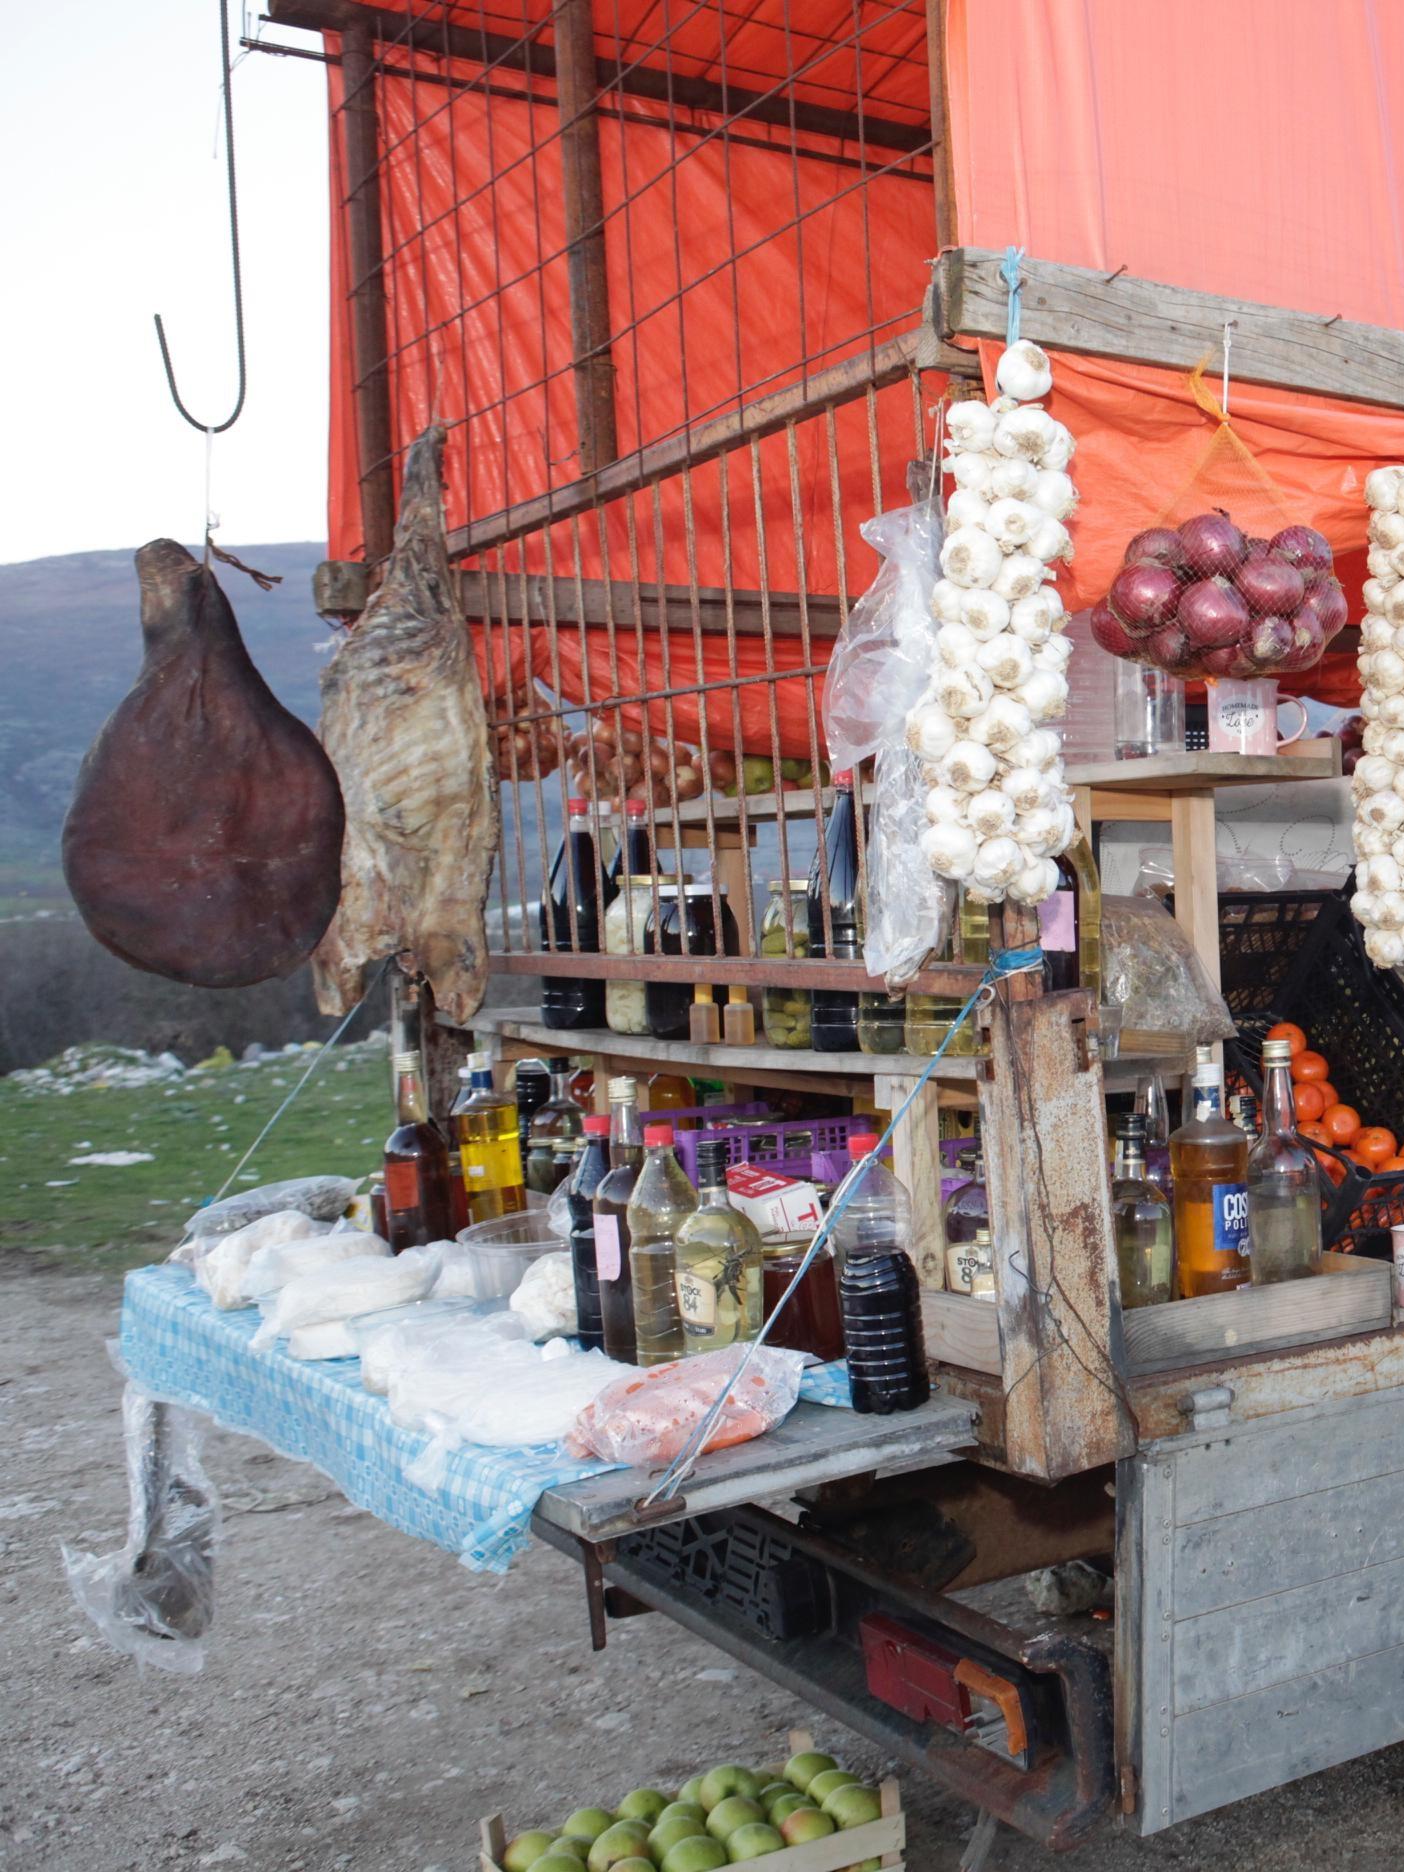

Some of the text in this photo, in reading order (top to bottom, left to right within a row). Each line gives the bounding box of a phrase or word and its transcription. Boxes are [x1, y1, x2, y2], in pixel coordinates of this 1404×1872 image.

[1223, 1191, 1248, 1221] COS
[1225, 1219, 1249, 1231] POLI
[957, 1257, 979, 1268] STO
[961, 1267, 973, 1284] 8
